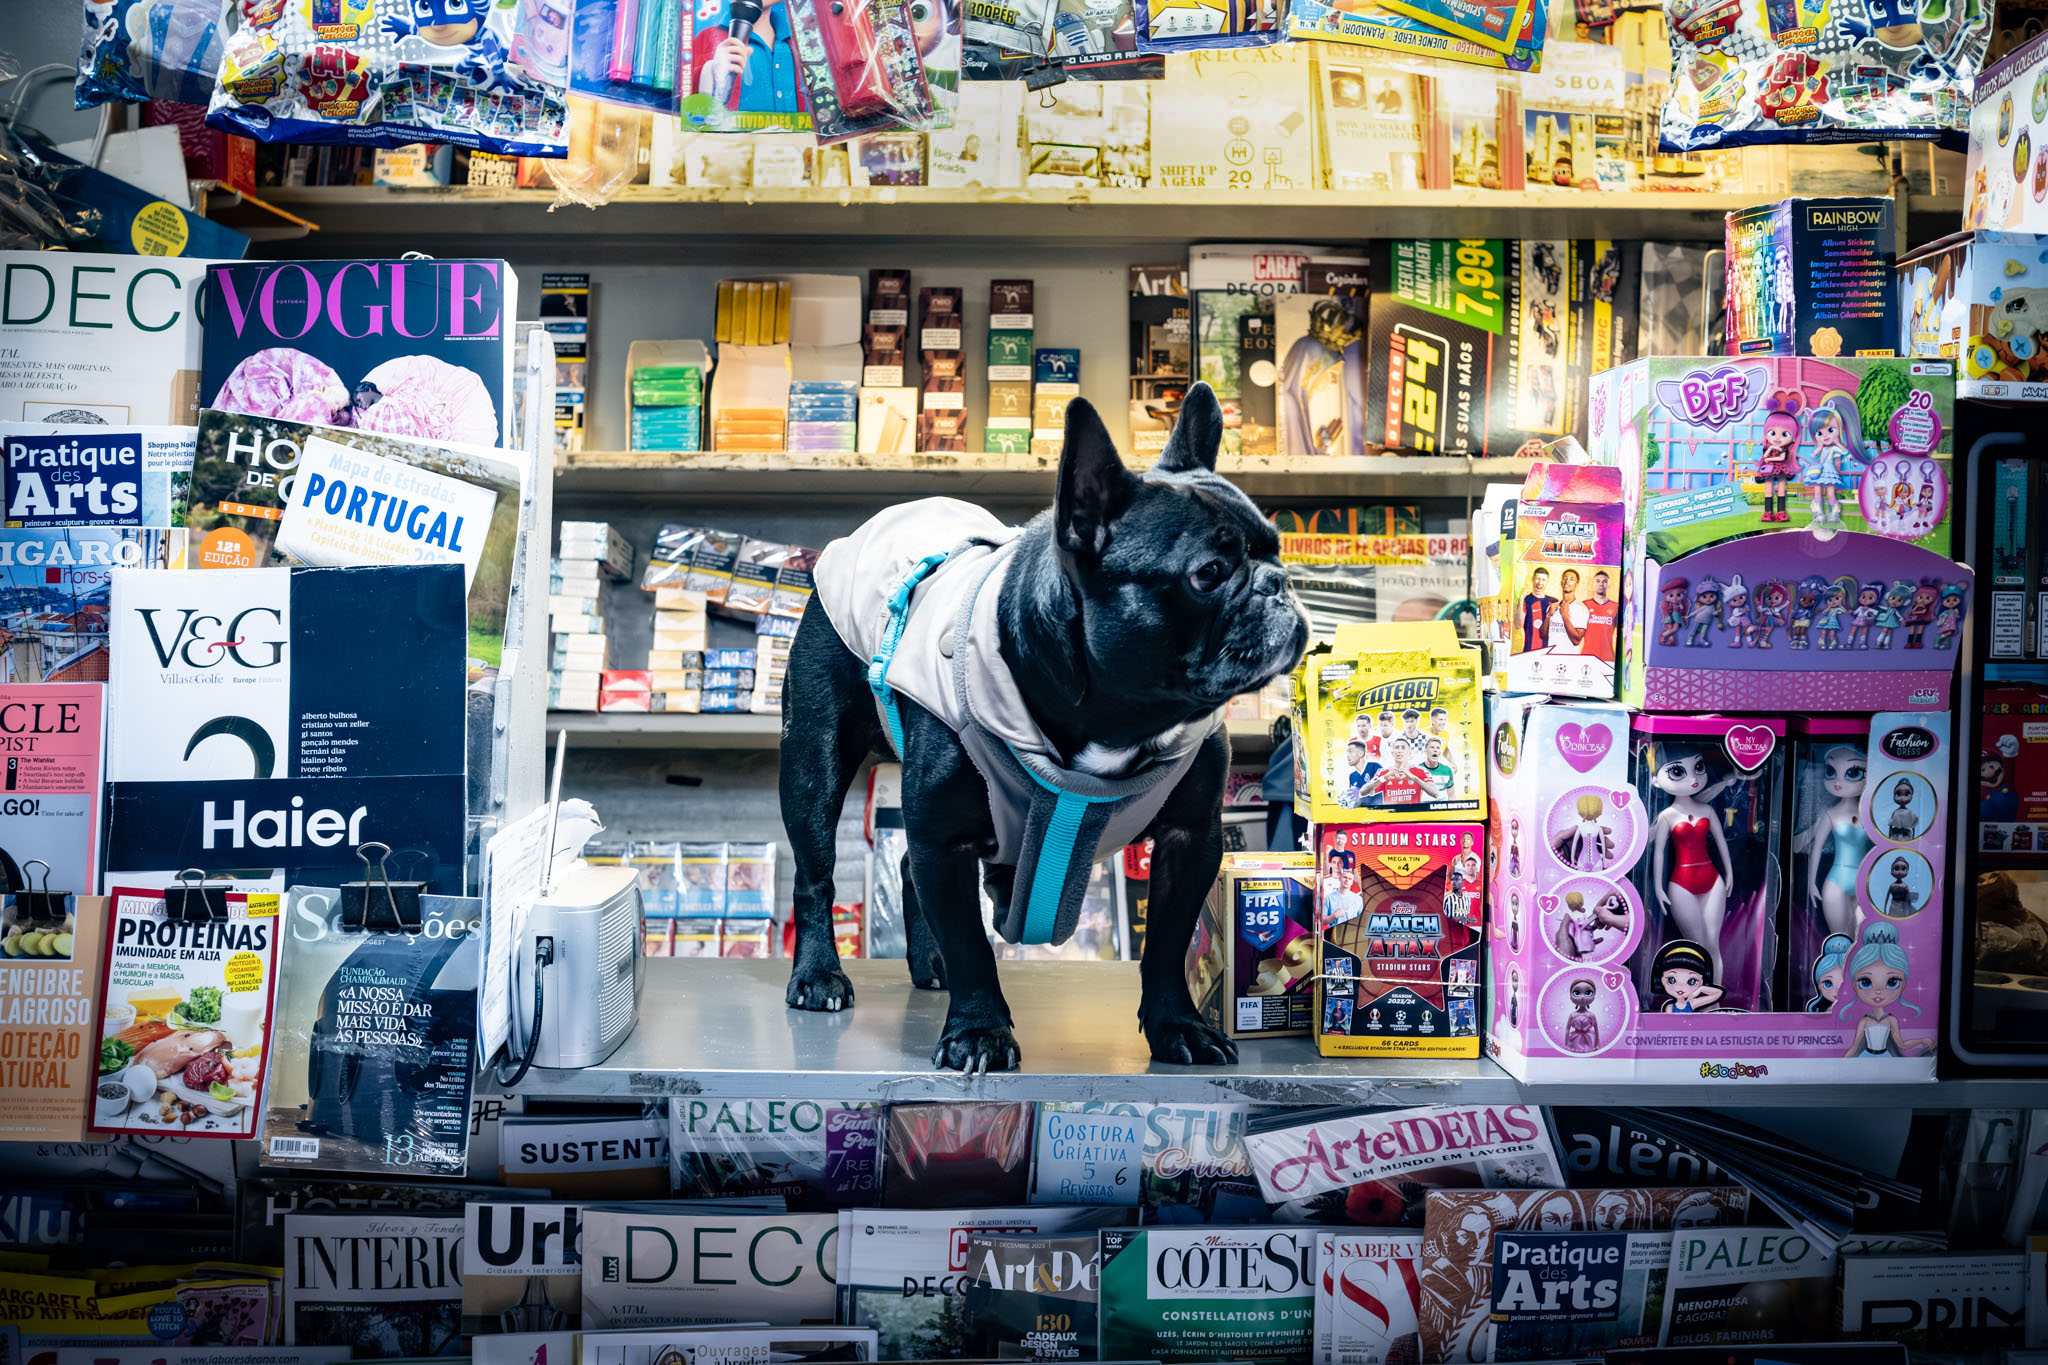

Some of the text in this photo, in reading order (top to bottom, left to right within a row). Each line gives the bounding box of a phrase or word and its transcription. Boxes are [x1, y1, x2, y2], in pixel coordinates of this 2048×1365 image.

[1342, 22, 1448, 50] DUENDE VERDE PLANADOR!
[1812, 211, 1881, 225] RAINBOW
[1822, 238, 1876, 247] Album Stickers
[1398, 243, 1414, 300] OFERTA DE
[1810, 260, 1838, 270] Images
[1811, 270, 1841, 280] Figurine
[209, 261, 499, 341] VOGUE
[1816, 291, 1844, 299] Cromos
[1811, 302, 1840, 310] Cromos
[45, 361, 66, 371] MAIS
[1459, 341, 1474, 387] MÃOS
[23, 371, 36, 380] DE
[27, 382, 79, 393] DECORAÇÃO
[1679, 371, 1748, 424] BFF
[1908, 391, 1932, 410] 20
[147, 440, 179, 450] Shopping
[9, 440, 136, 474] Pratique
[147, 450, 166, 458] Notre
[147, 459, 163, 468] pour
[50, 467, 81, 483] des
[329, 452, 458, 505] Mapa de Estradas
[9, 471, 139, 517] Arts
[302, 472, 465, 554] PORTUGAL
[1545, 521, 1596, 537] MATCH
[1283, 538, 1332, 555] LIVROS
[203, 551, 250, 568] EDIÇÃO
[134, 607, 288, 670] V&G
[232, 676, 257, 684] Europe
[1359, 680, 1434, 707] FUTEBOL
[301, 711, 358, 720] alberto bulhosa
[301, 720, 334, 729] cristiano
[349, 720, 370, 728] zeller
[309, 730, 333, 738] santos
[1889, 732, 1930, 749] Fashion
[301, 737, 359, 748] gonçalo mendes
[301, 747, 346, 756] hernâni dias
[1896, 748, 1921, 756] DRESS
[300, 756, 343, 765] idalino leão
[300, 764, 348, 773] ivone ribeiro
[202, 795, 369, 850] Haier
[1351, 832, 1457, 848] STADIUM STARS
[1245, 895, 1280, 908] FIFA
[1245, 911, 1280, 926] 365
[1368, 914, 1440, 933] MATCH
[115, 945, 221, 961] IMUNIDADE EM ALTA
[1366, 939, 1441, 959] ATTAX
[114, 961, 182, 972] Ajudam MEMÓRIA,
[228, 959, 257, 967] PROTEGER
[1376, 962, 1432, 972] STADIUM STARS
[119, 970, 185, 980] HUMOR MASSA
[234, 972, 256, 980] CONTRA
[340, 966, 386, 977] FUNDAÇÃO
[113, 977, 155, 988] MUSCULAR
[339, 975, 407, 986] CHAMPALIMAUD
[358, 986, 405, 1001] NOSSA
[337, 998, 433, 1018] MISSÃO É DAR
[1240, 1001, 1259, 1009] FIFA
[335, 1015, 408, 1031] MAIS VIDA
[334, 1027, 424, 1047] ÀS PESSOAS»
[1625, 1033, 1844, 1047] CONVIÉRTETE EN LA ESTILISTA DE TU PRINCESA
[1699, 1062, 1769, 1079] #sbabam
[688, 1100, 824, 1134] PALEO
[1048, 1114, 1136, 1145] COSTURA
[381, 1133, 415, 1167] 13
[1270, 1104, 1540, 1193] ArteIDEIAS
[1352, 1143, 1536, 1179] UM MUNDO EM LAVORES
[1114, 1166, 1128, 1187] 6
[1105, 1236, 1123, 1245] TOP
[1339, 1242, 1402, 1259] SABER
[1500, 1240, 1620, 1272] Pratique
[1685, 1235, 1811, 1273] PALEO
[1539, 1265, 1568, 1281] des
[1496, 1269, 1618, 1311] Arts
[609, 1304, 648, 1315] NATAL
[1676, 1295, 1749, 1312] MENOPAUSA
[150, 1315, 184, 1323] LOVE TO
[1035, 1313, 1071, 1332] 130
[1161, 1310, 1276, 1322] CONSTELLATIONS
[1685, 1308, 1728, 1323] AGORA?
[152, 1321, 181, 1332] STITCH
[1026, 1331, 1078, 1342] CADEAUX
[1716, 1328, 1775, 1342] FARINHAS
[697, 1343, 769, 1358] Ouvrages
[1020, 1338, 1059, 1350] DESIGN
